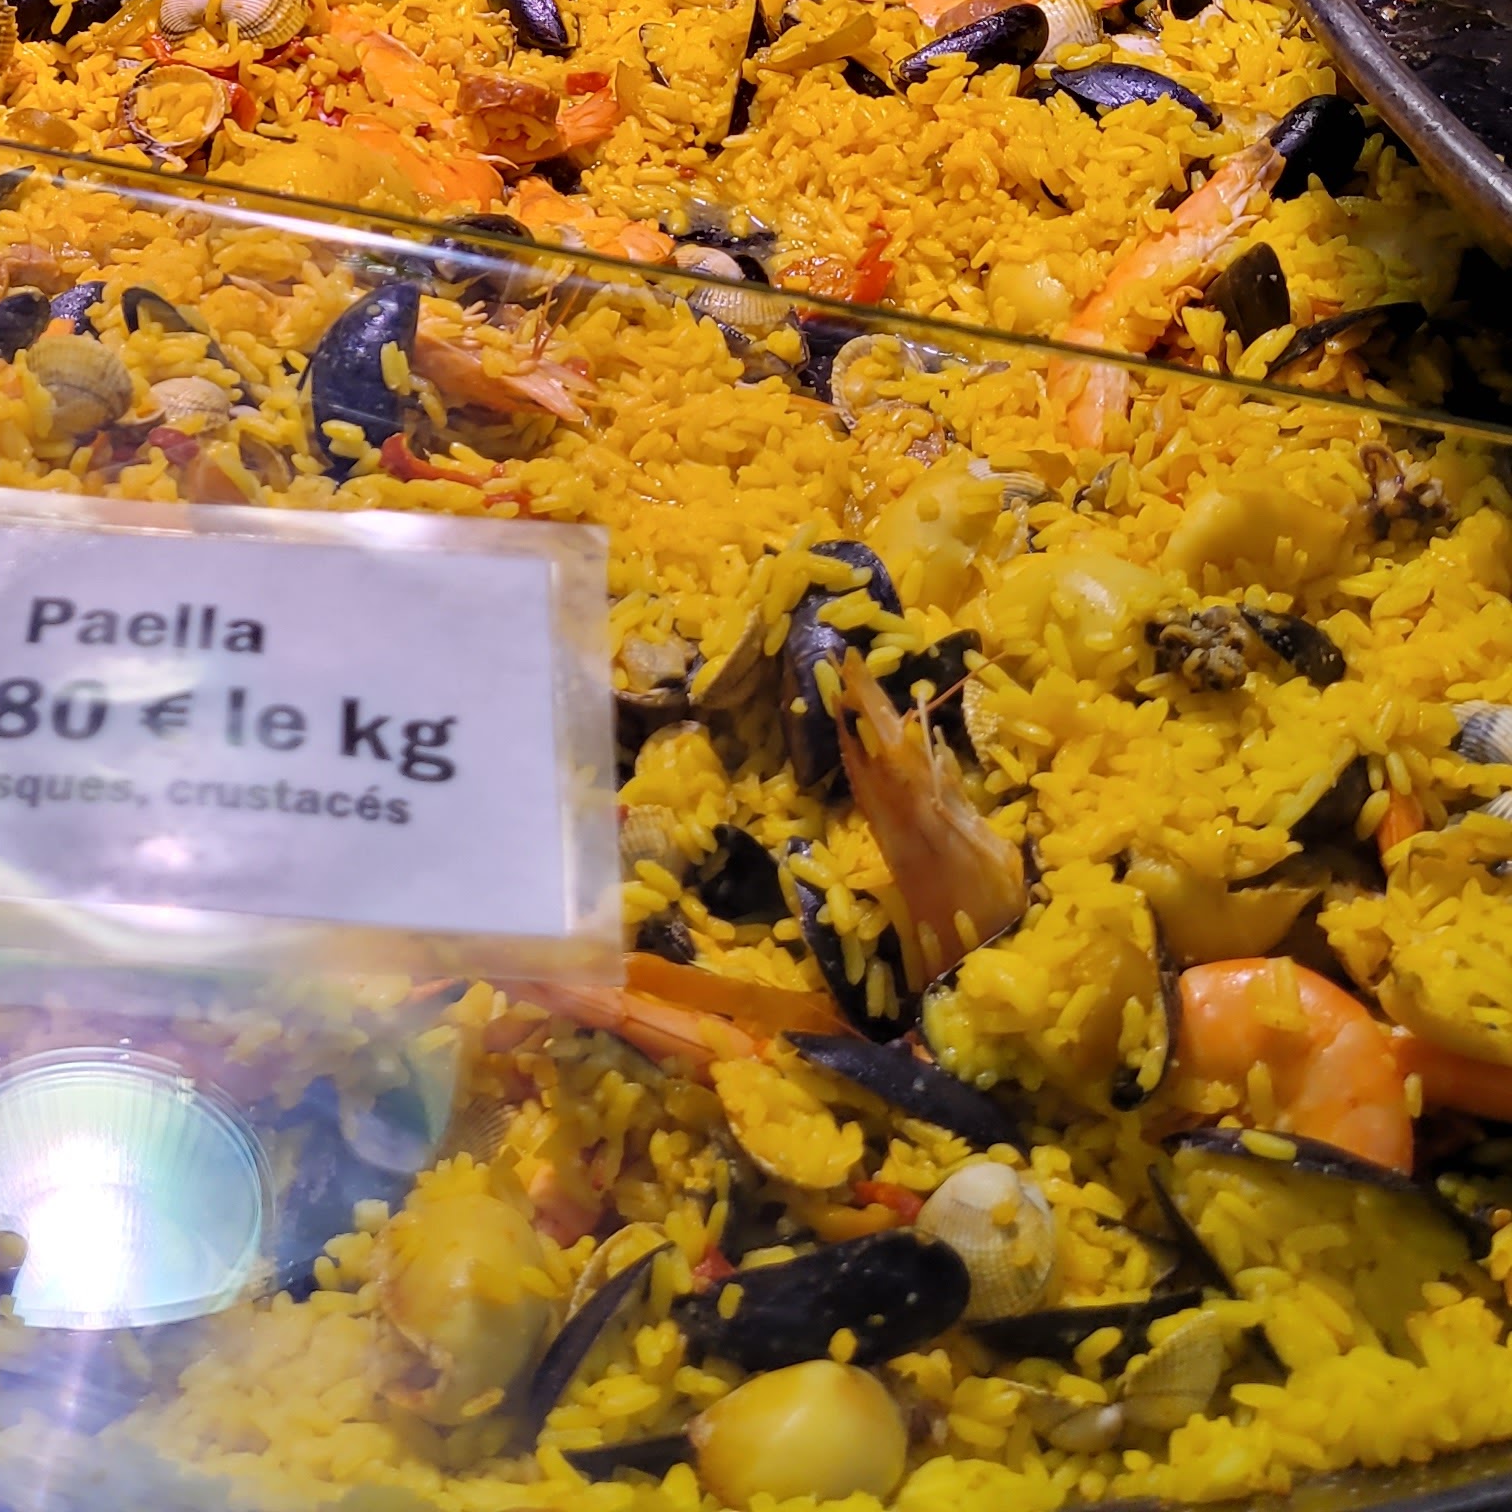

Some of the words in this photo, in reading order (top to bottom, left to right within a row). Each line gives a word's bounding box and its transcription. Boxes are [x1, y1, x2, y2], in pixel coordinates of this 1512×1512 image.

[25, 596, 267, 655] Paella
[140, 688, 192, 740] €
[224, 686, 308, 752] le
[338, 696, 460, 784] kg
[164, 770, 412, 826] crustacés
